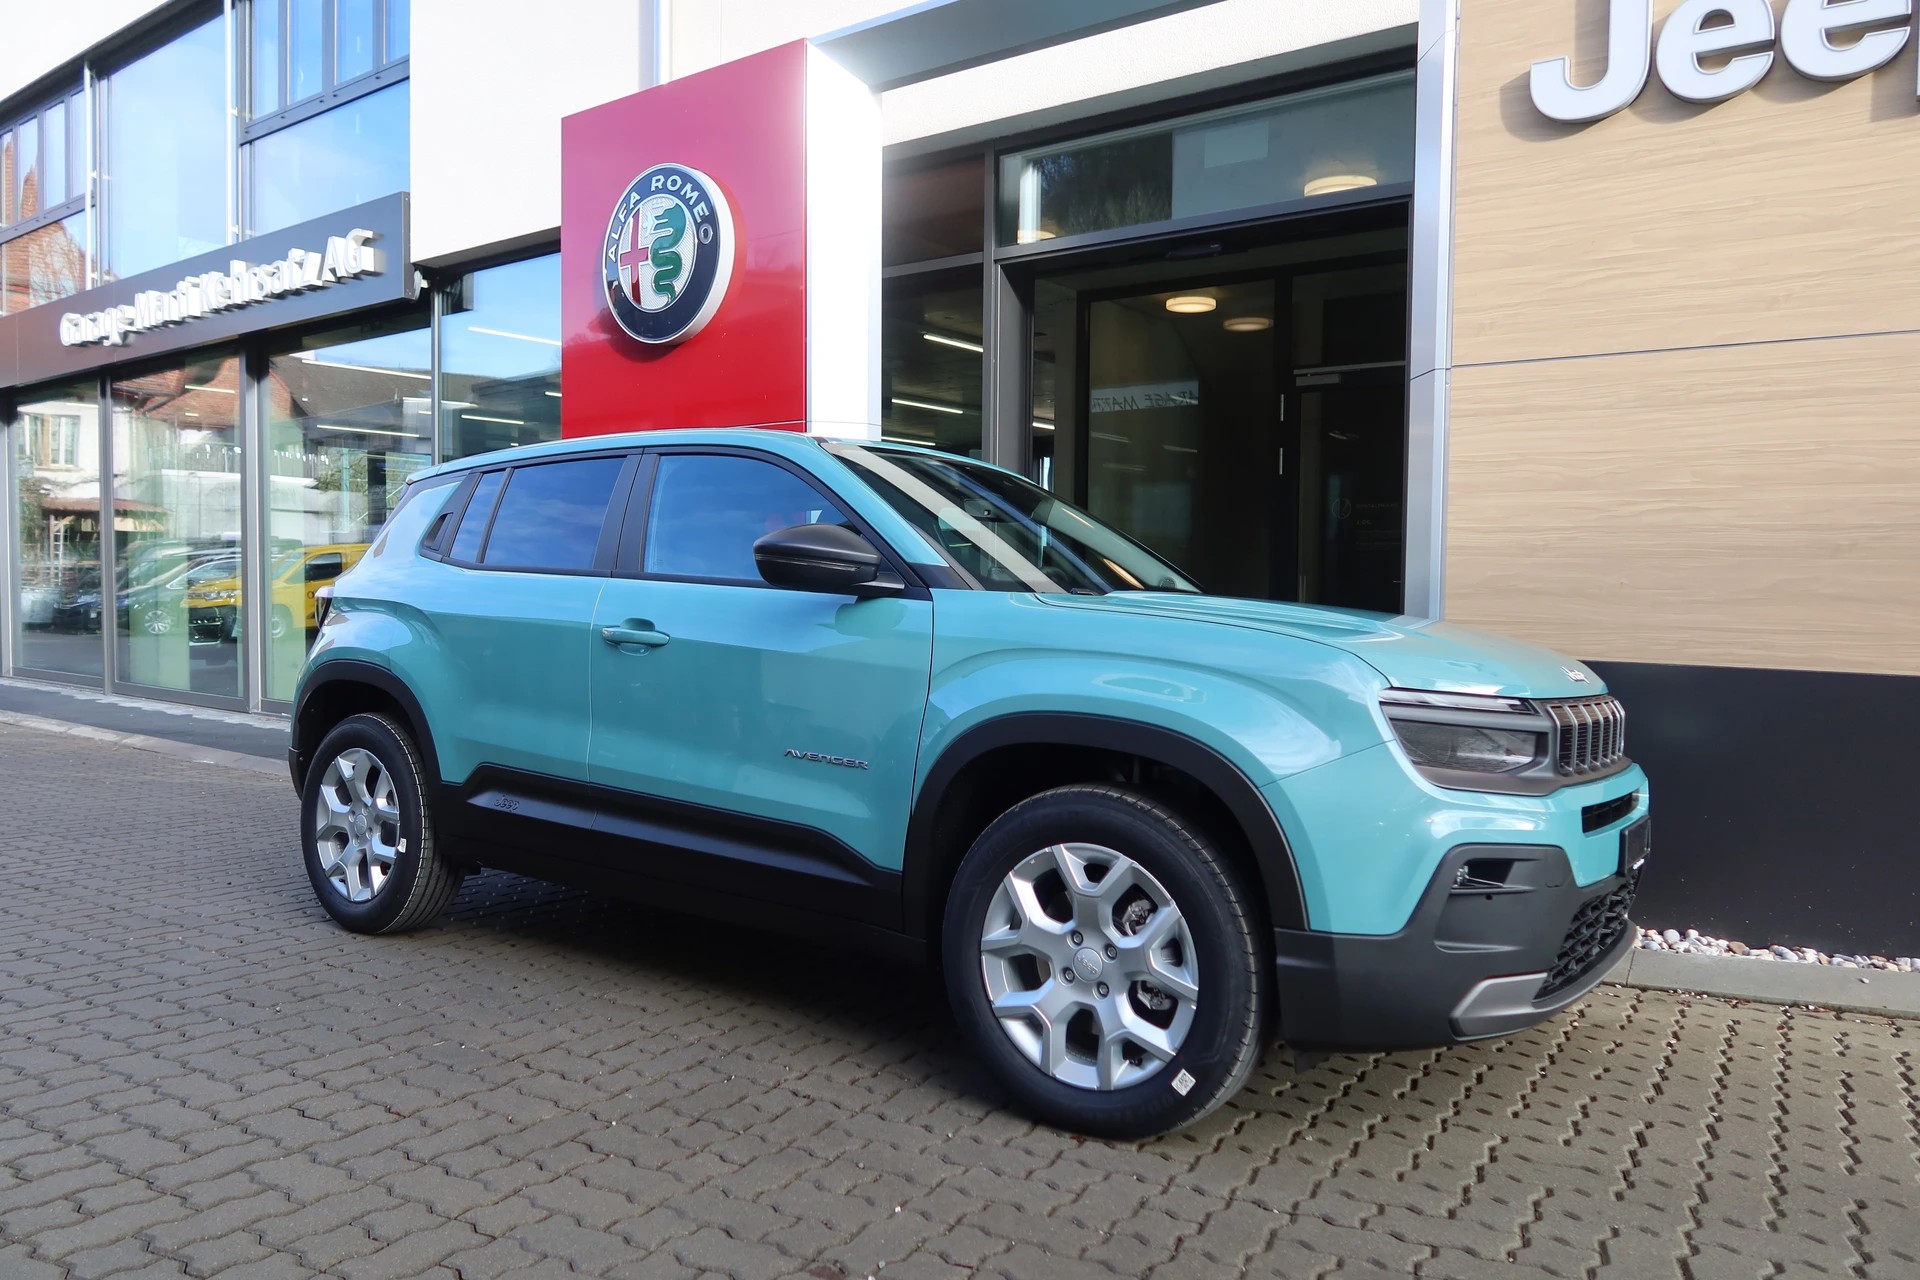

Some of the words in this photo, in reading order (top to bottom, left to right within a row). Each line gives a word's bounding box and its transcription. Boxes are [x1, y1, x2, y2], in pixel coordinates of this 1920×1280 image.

[1529, 0, 1920, 123] Jee
[608, 191, 642, 262] ALFA
[650, 174, 714, 245] ROMEO
[322, 228, 374, 282] AG
[784, 748, 868, 769] AVENGER
